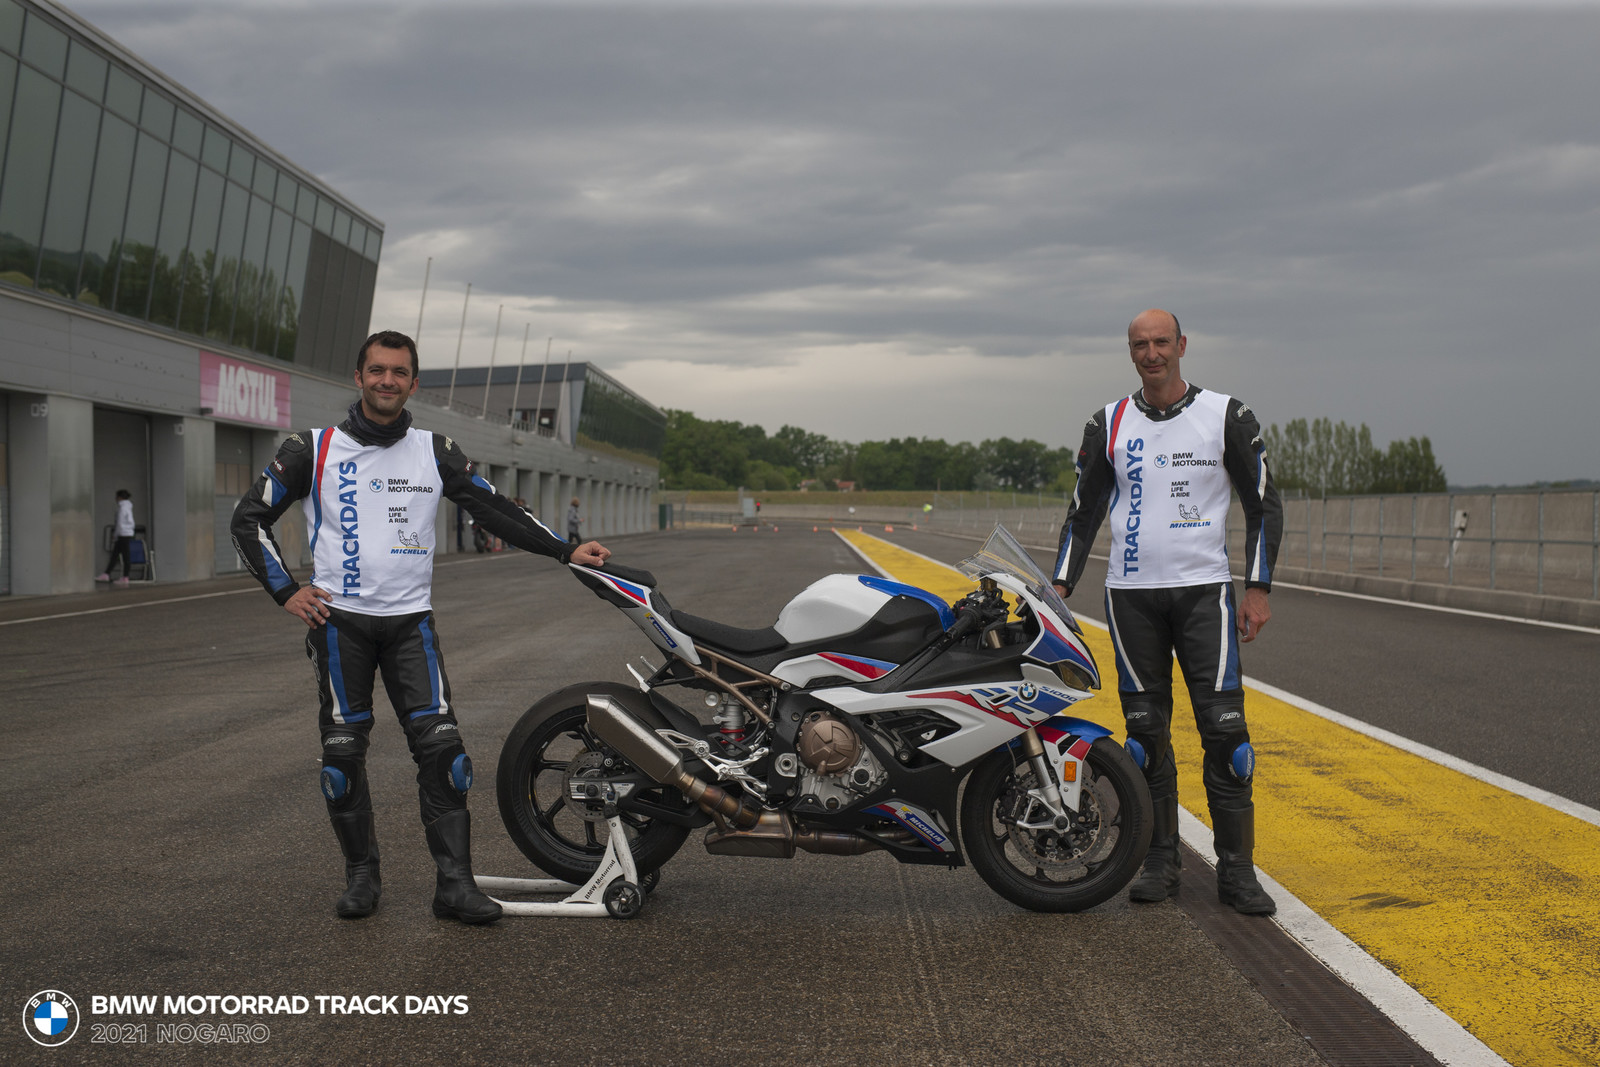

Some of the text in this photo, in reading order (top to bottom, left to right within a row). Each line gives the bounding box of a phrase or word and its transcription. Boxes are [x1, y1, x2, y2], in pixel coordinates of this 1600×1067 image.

[218, 363, 278, 422] MOTUL
[30, 403, 48, 417] 09
[1172, 452, 1193, 460] BMW
[388, 478, 409, 486] BMW
[1123, 438, 1145, 577] TRACKDAYS
[338, 461, 361, 598] TRACKDAYS
[1169, 521, 1212, 529] MICHELIN
[1040, 685, 1079, 702] S1000
[909, 817, 943, 842] MICHELIN
[584, 859, 616, 900] BMW Motorrad
